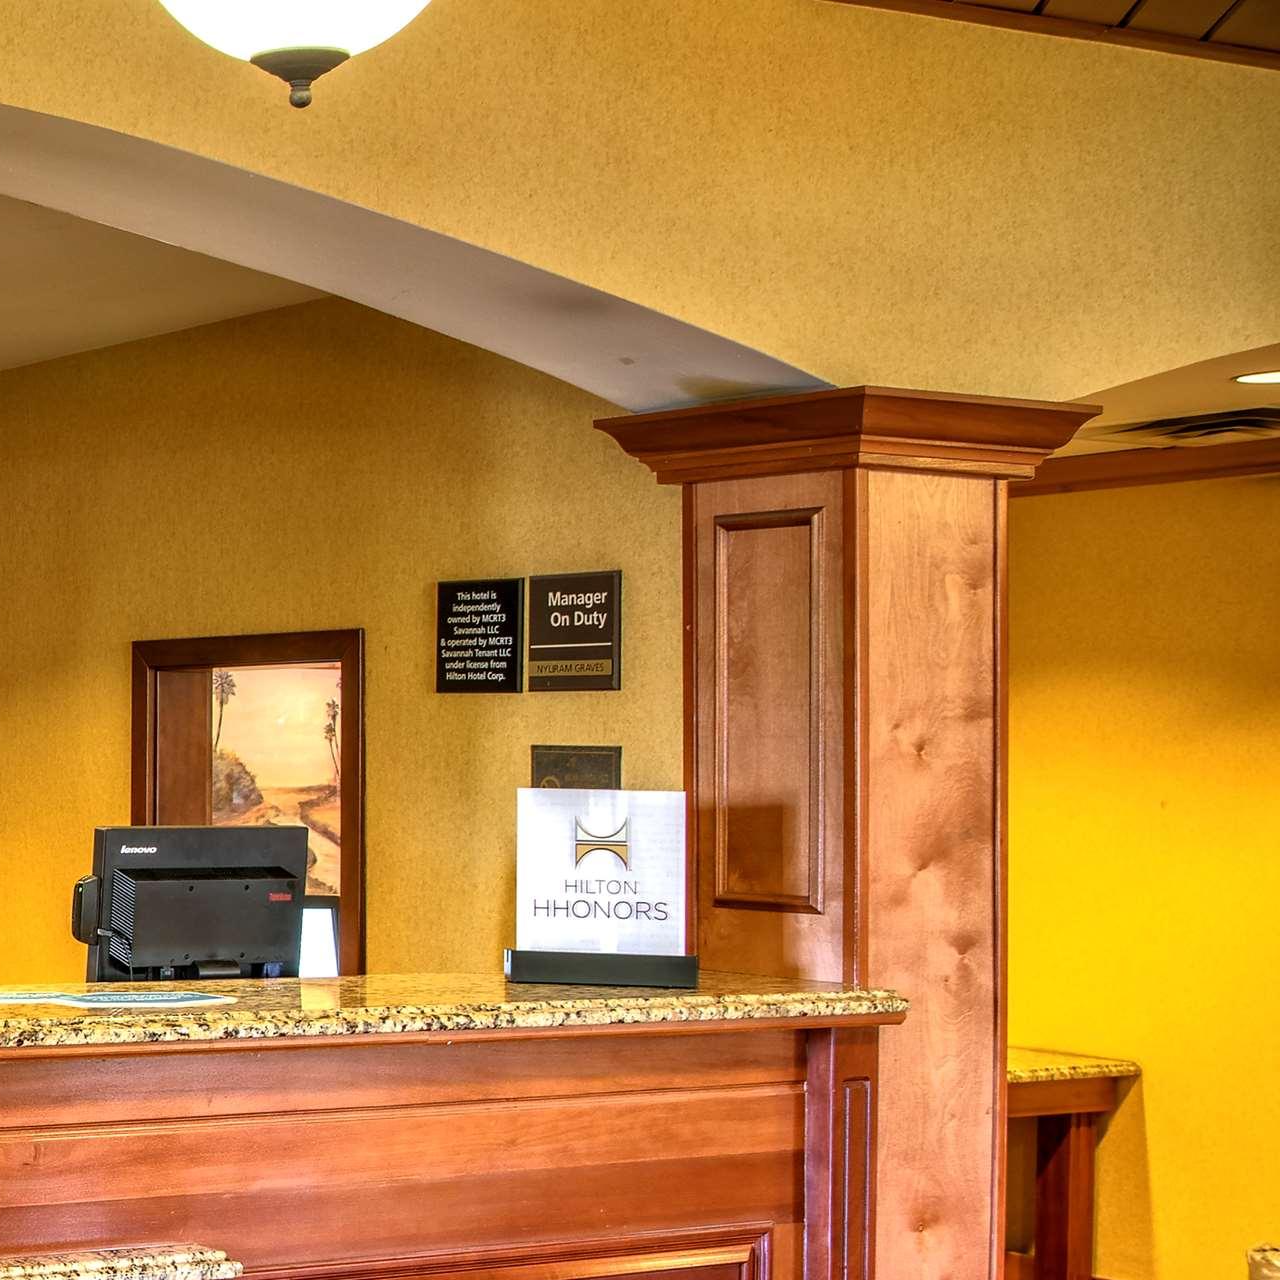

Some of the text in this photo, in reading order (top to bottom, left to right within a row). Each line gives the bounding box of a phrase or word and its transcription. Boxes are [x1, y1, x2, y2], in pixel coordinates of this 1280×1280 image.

[456, 590, 497, 600] This hotel is
[548, 591, 608, 608] Manager
[452, 602, 501, 613] independently
[447, 613, 506, 625] owned by MCRT3
[550, 611, 607, 629] On Duty
[453, 625, 500, 635] Savannah LLC
[440, 636, 513, 648] & operated by MCRT3
[441, 647, 512, 657] Savannah Tenant LLC
[445, 659, 507, 669] under license from
[574, 662, 604, 672] GRAVES
[446, 671, 506, 682] Hilton Hotel Corp.
[120, 844, 158, 854] lenovo
[564, 879, 638, 895] HILTON
[533, 899, 669, 921] HHONORS
